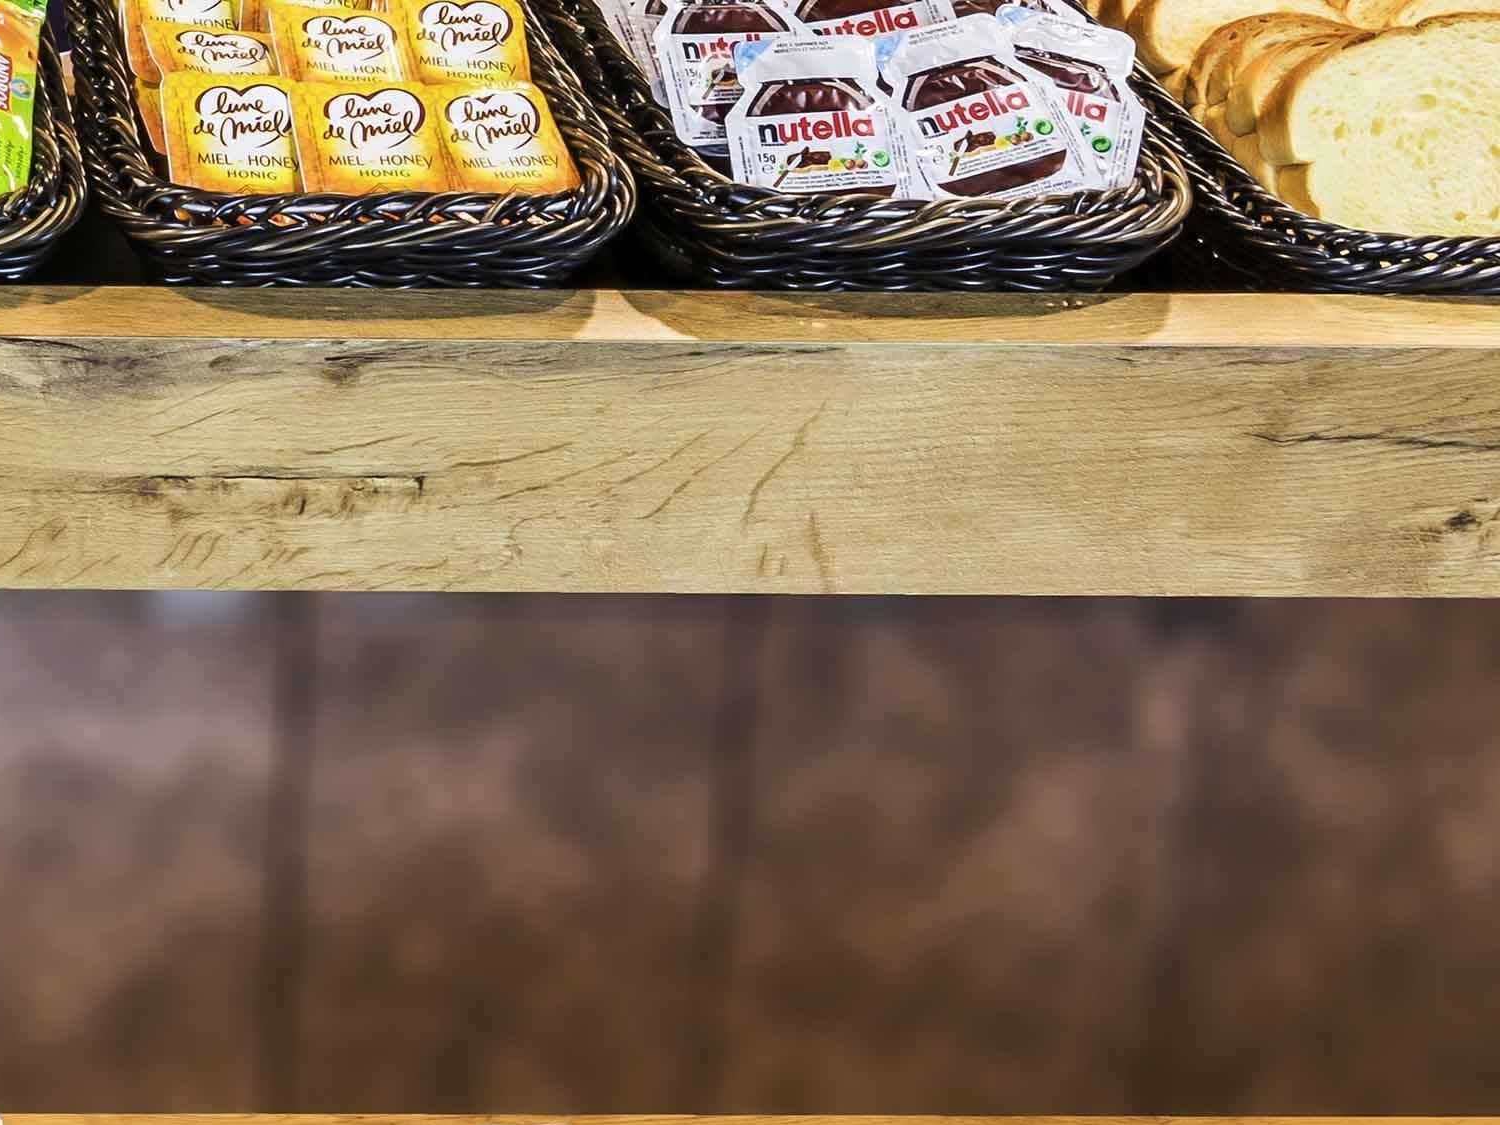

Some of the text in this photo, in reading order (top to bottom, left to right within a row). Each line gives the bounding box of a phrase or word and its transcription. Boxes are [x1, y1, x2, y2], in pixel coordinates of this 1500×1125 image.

[420, 56, 516, 75] MIEL HONEY
[917, 90, 1029, 136] nutella
[758, 112, 875, 143] nutella
[197, 152, 299, 171] MIEL HONEY
[328, 154, 433, 171] MIEL HONEY
[461, 155, 558, 171] MIEL HONEY
[757, 153, 776, 164] 15g
[227, 169, 277, 181] HONIG
[359, 167, 411, 179] HONIG
[493, 169, 542, 179] HONIG
